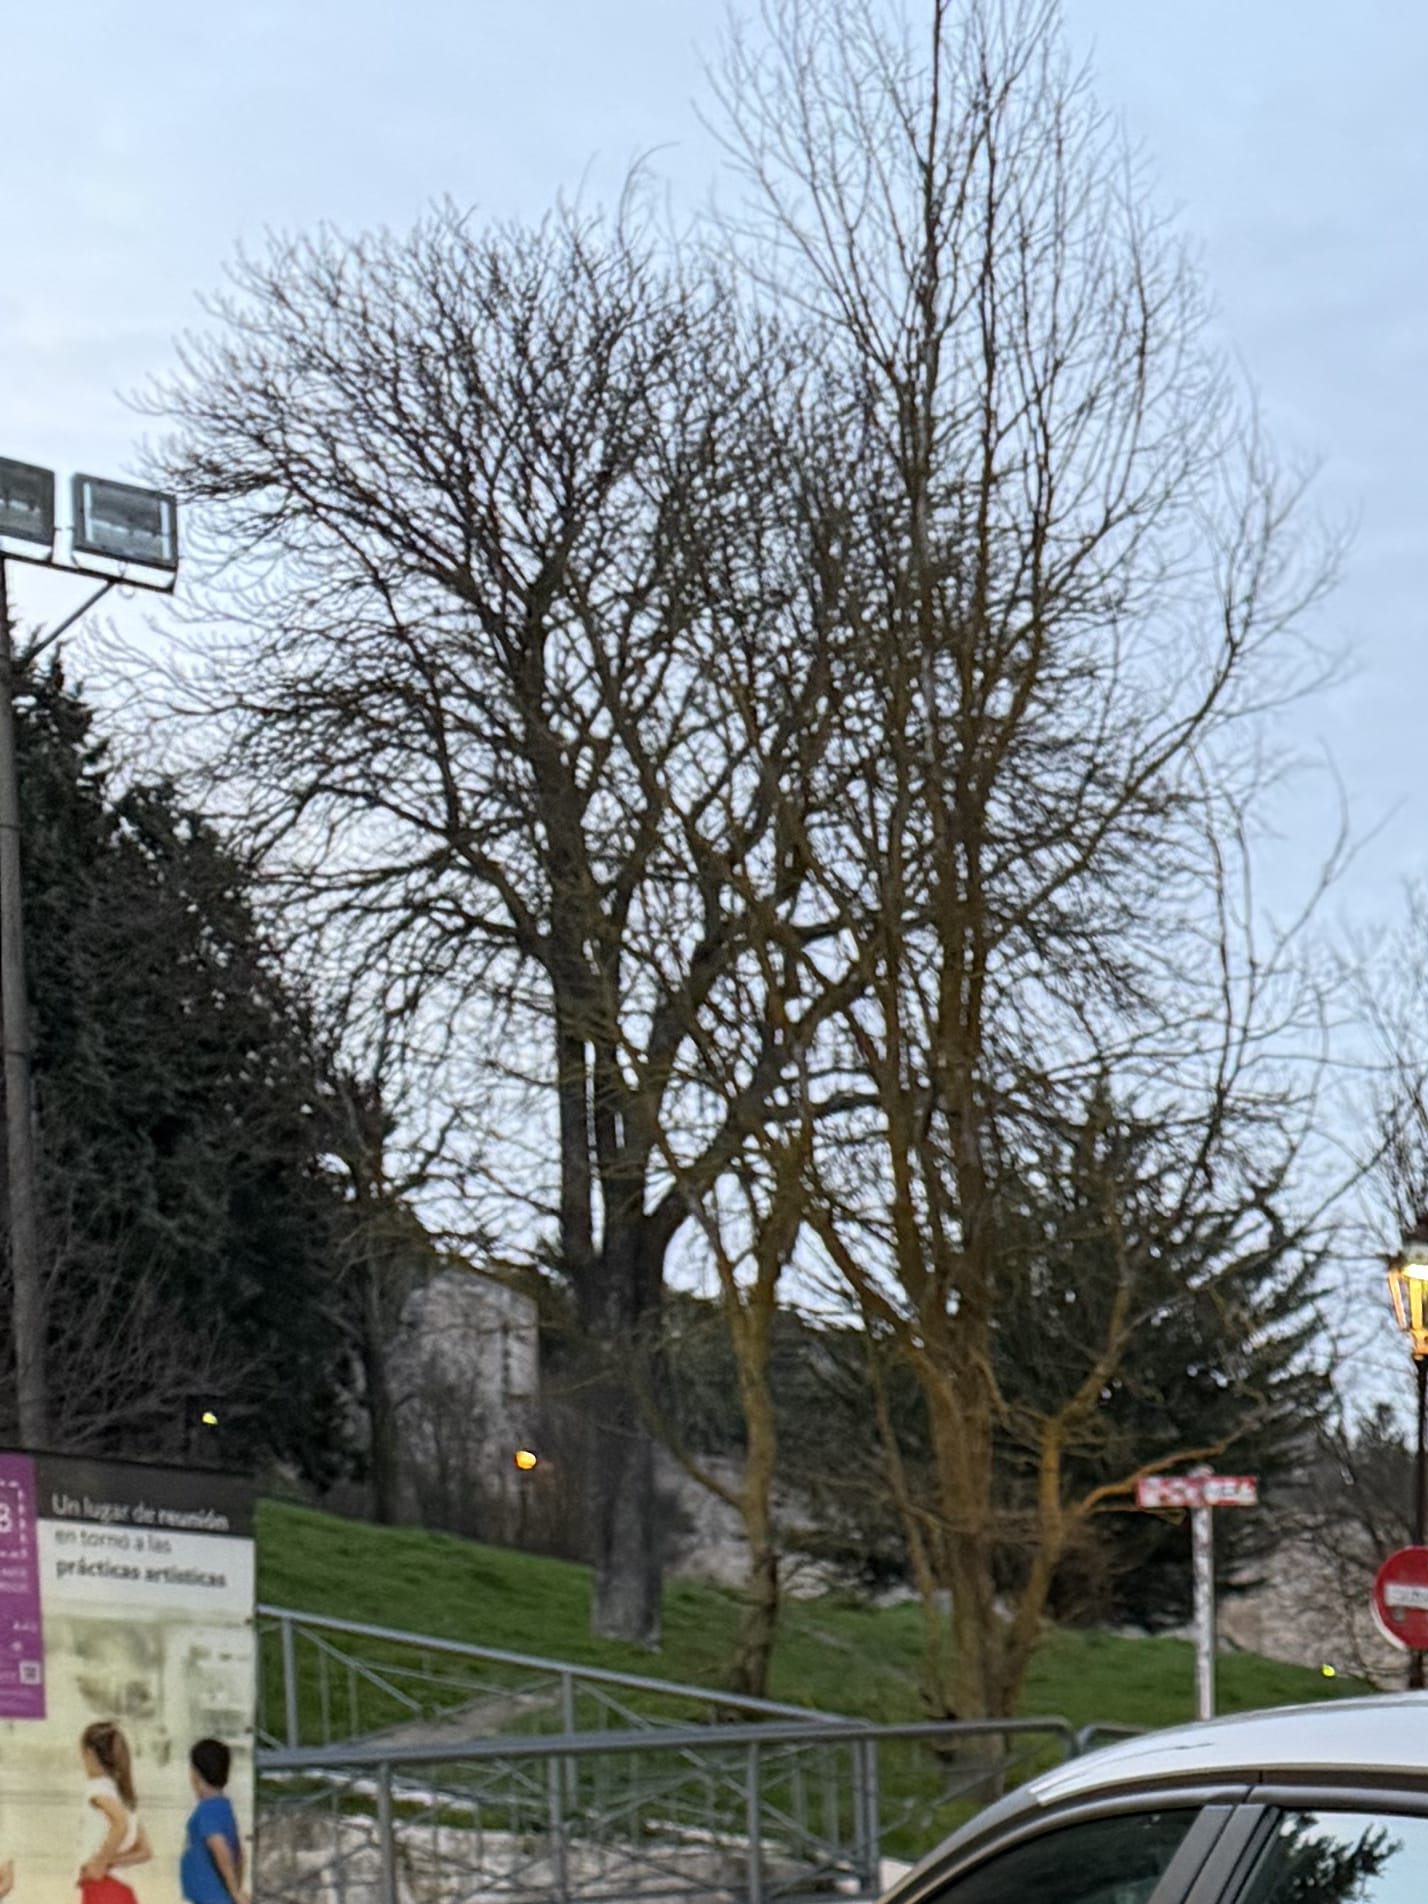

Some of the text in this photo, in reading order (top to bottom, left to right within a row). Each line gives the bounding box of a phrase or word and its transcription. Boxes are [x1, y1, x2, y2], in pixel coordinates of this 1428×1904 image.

[52, 1493, 81, 1516] Un
[83, 1496, 129, 1524] lugar
[131, 1500, 156, 1523] de
[55, 1530, 76, 1545] en
[80, 1530, 130, 1550] torno
[147, 1534, 173, 1554] las
[56, 1556, 141, 1580] prácticas
